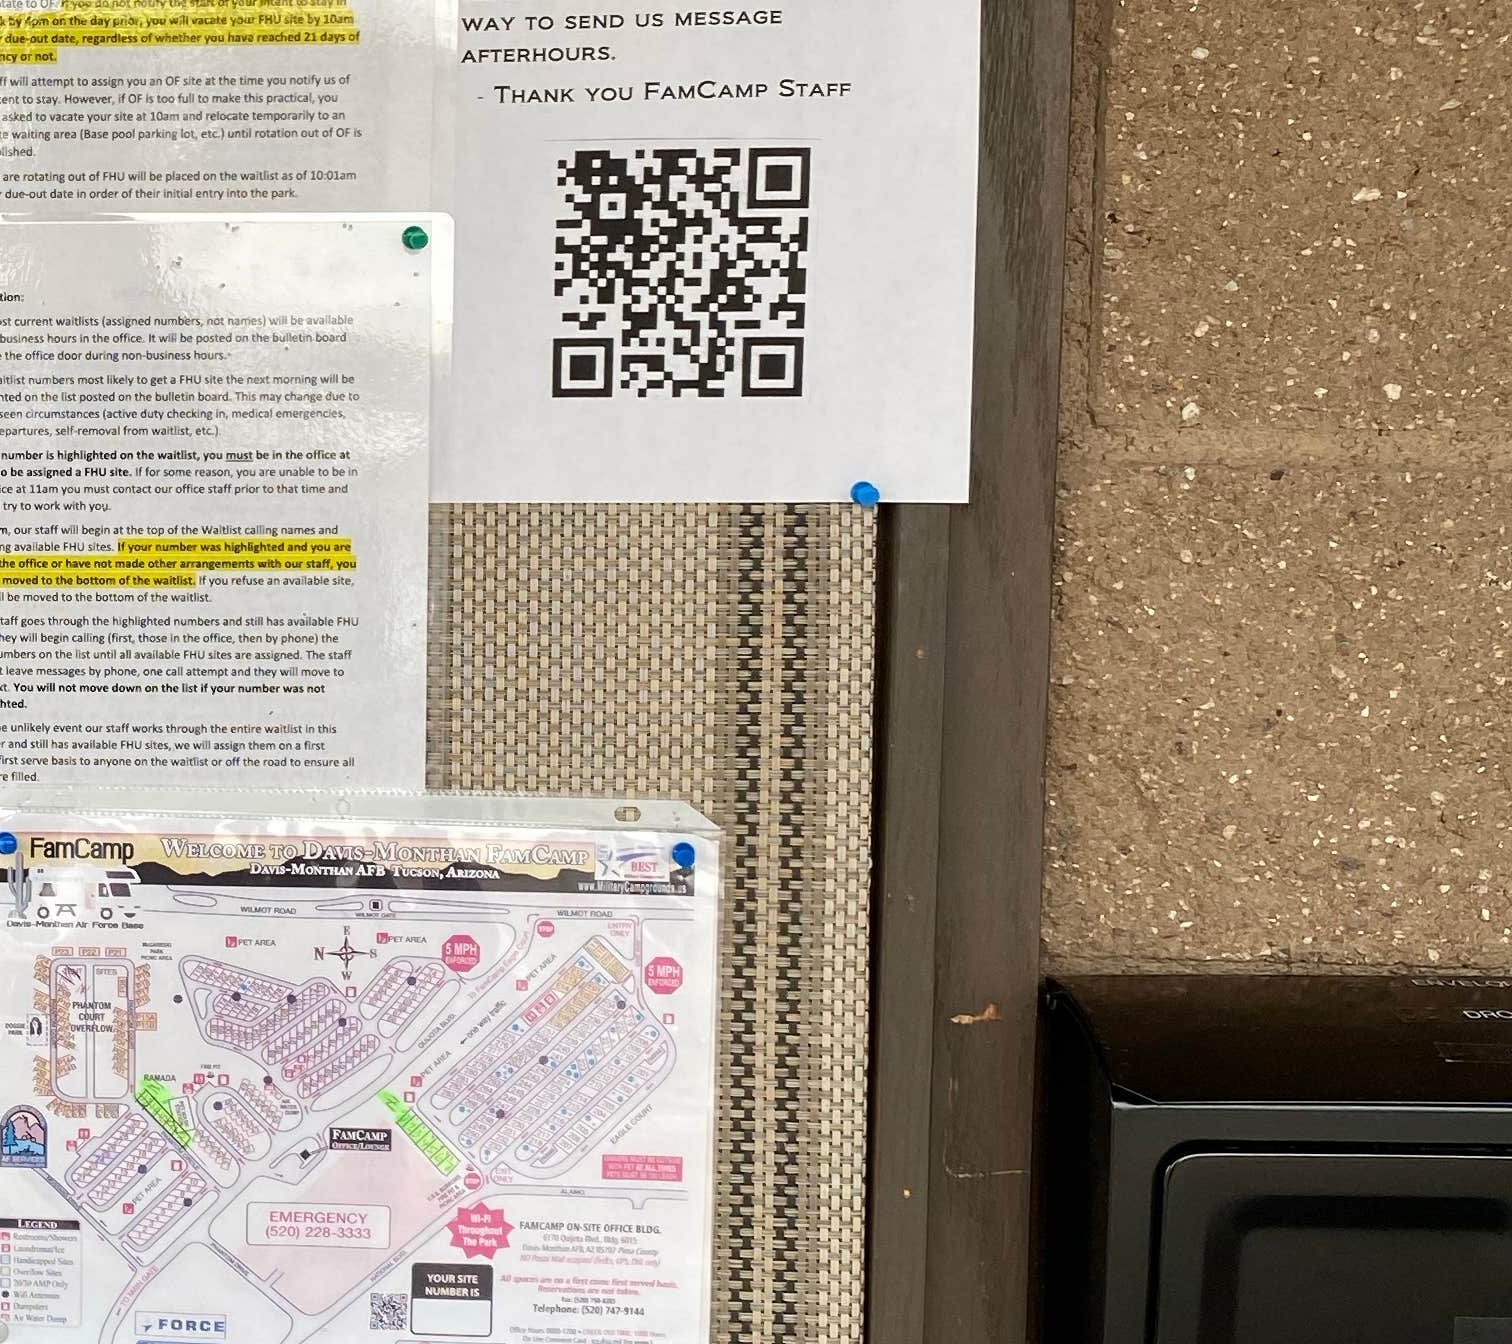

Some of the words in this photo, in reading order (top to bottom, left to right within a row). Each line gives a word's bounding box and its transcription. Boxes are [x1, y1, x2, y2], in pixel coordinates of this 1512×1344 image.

[460, 46, 616, 63] AFTERHOURS.
[584, 86, 633, 102] YOU
[10, 771, 39, 781] filled.
[30, 838, 135, 864] FamCamp
[160, 838, 266, 859] WELCOME
[269, 845, 296, 859] TO
[301, 839, 483, 864] DAVIS-MONTHAN
[485, 843, 589, 866] FAMCAMP
[249, 862, 354, 877] DAVIS-MONTHAN
[356, 865, 386, 878] AFB
[391, 865, 444, 880] TUCSON,
[445, 867, 500, 880] ARIZONA
[72, 1002, 112, 1011] PHANTOM
[78, 1013, 106, 1022] COURT
[17, 1219, 59, 1230] LEGEND
[269, 1210, 368, 1225] EMERGENCY
[265, 1225, 301, 1239] (520)
[304, 1226, 372, 1240] 228-3333
[427, 1273, 456, 1285] YOUR
[458, 1274, 479, 1285] SITE
[425, 1286, 468, 1297] NUMBER
[470, 1287, 480, 1298] IS
[158, 1319, 226, 1333] FORCE
